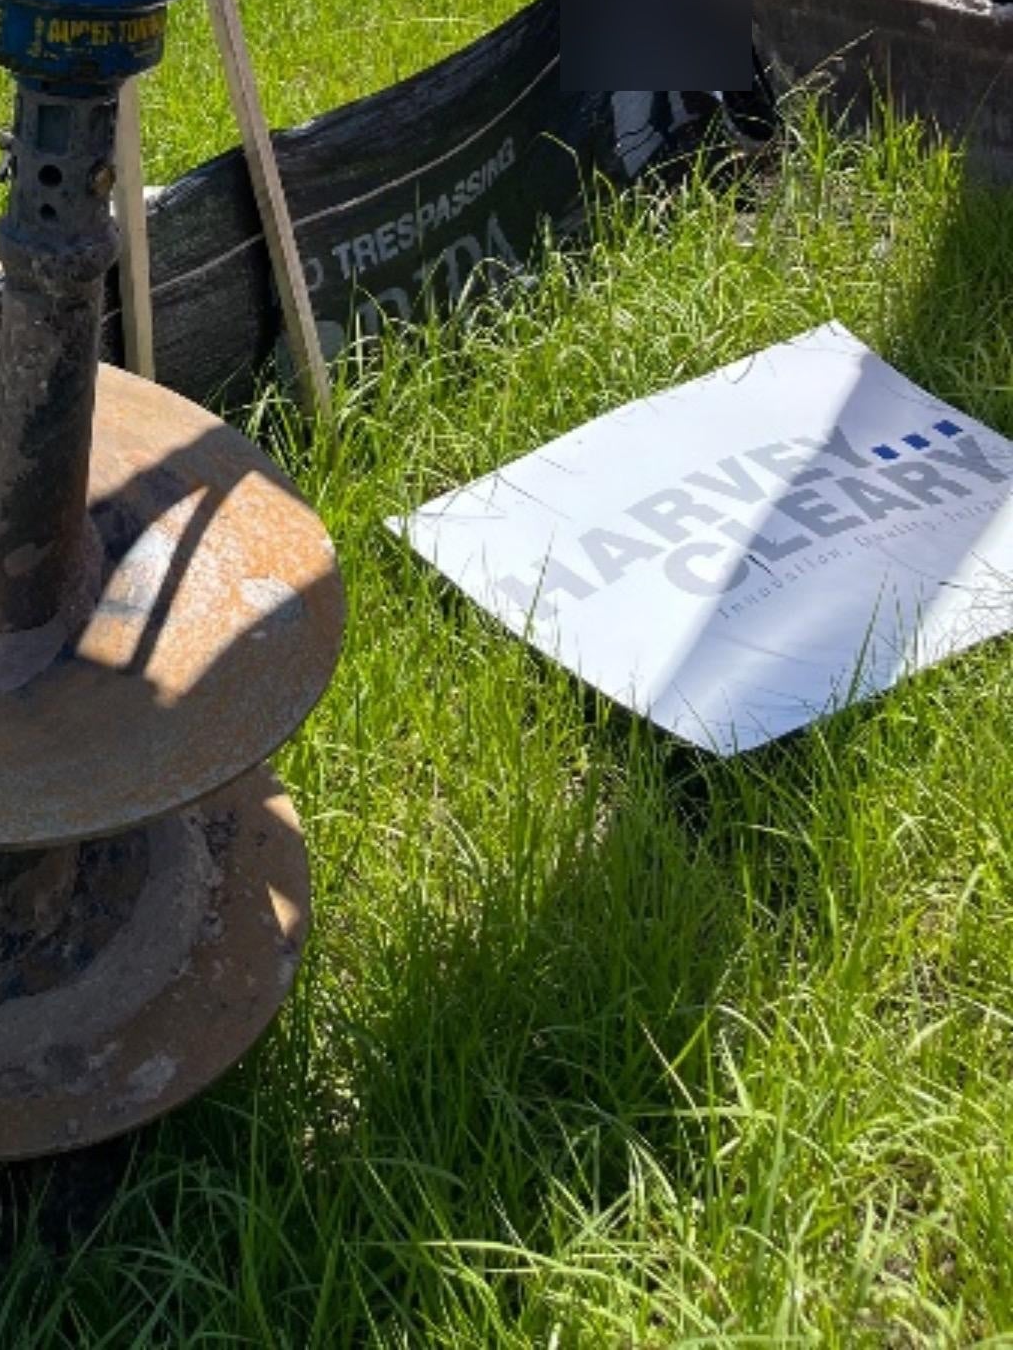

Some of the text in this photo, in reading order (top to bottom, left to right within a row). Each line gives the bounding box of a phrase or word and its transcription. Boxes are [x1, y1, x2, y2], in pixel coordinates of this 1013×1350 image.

[331, 136, 517, 280] TRESPASSING
[492, 425, 873, 621] HARVEY
[665, 433, 1009, 598] CLEARY
